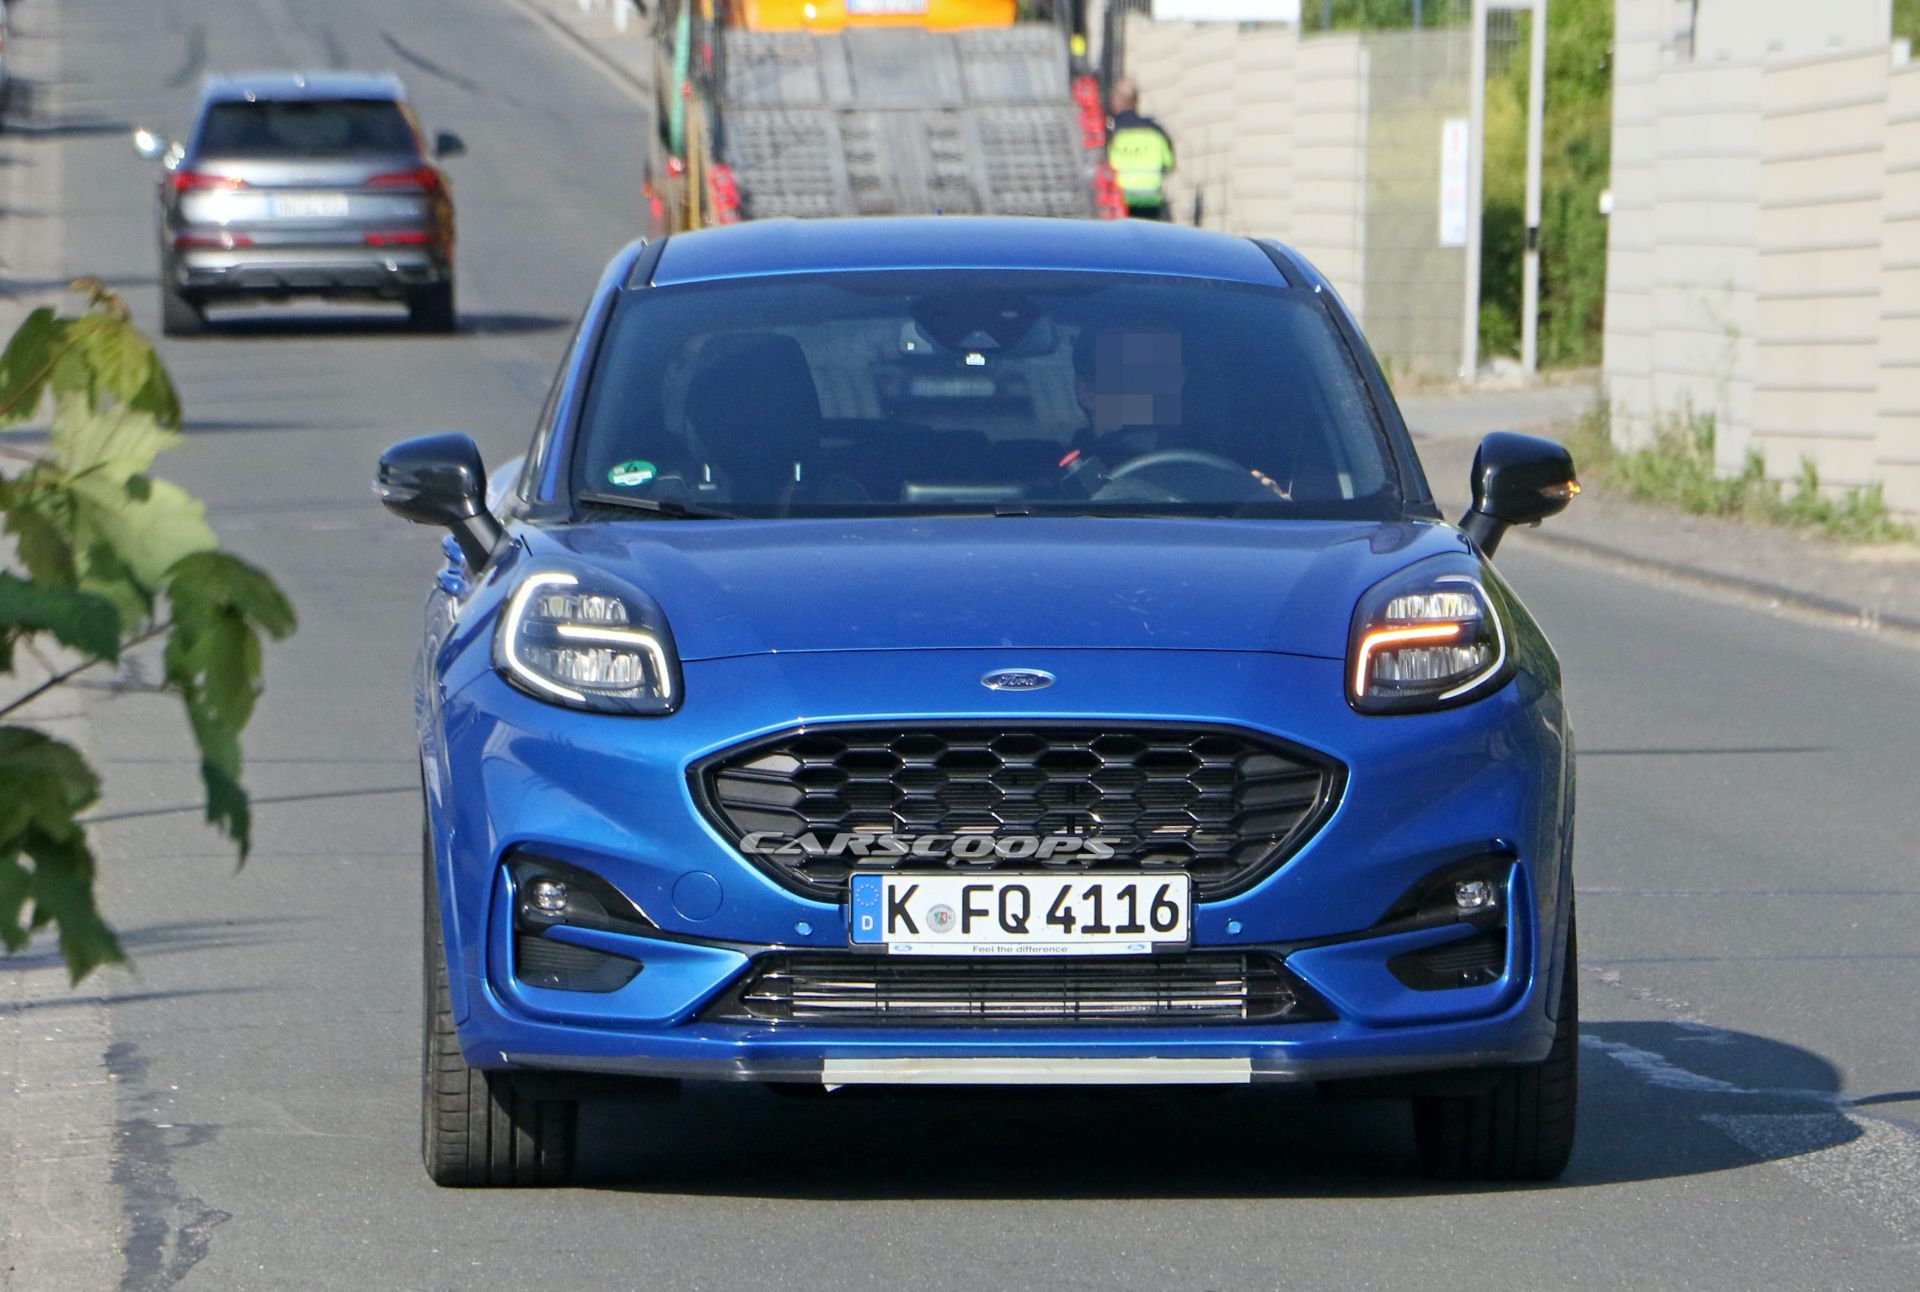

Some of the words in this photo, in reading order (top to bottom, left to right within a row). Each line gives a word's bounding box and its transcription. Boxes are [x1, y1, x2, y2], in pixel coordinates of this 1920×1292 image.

[887, 884, 920, 934] K
[961, 884, 1031, 934] FQ
[1046, 884, 1179, 934] 4116
[861, 915, 874, 931] D
[972, 945, 994, 953] Feel
[996, 945, 1013, 953] the
[1016, 945, 1068, 953] difference
